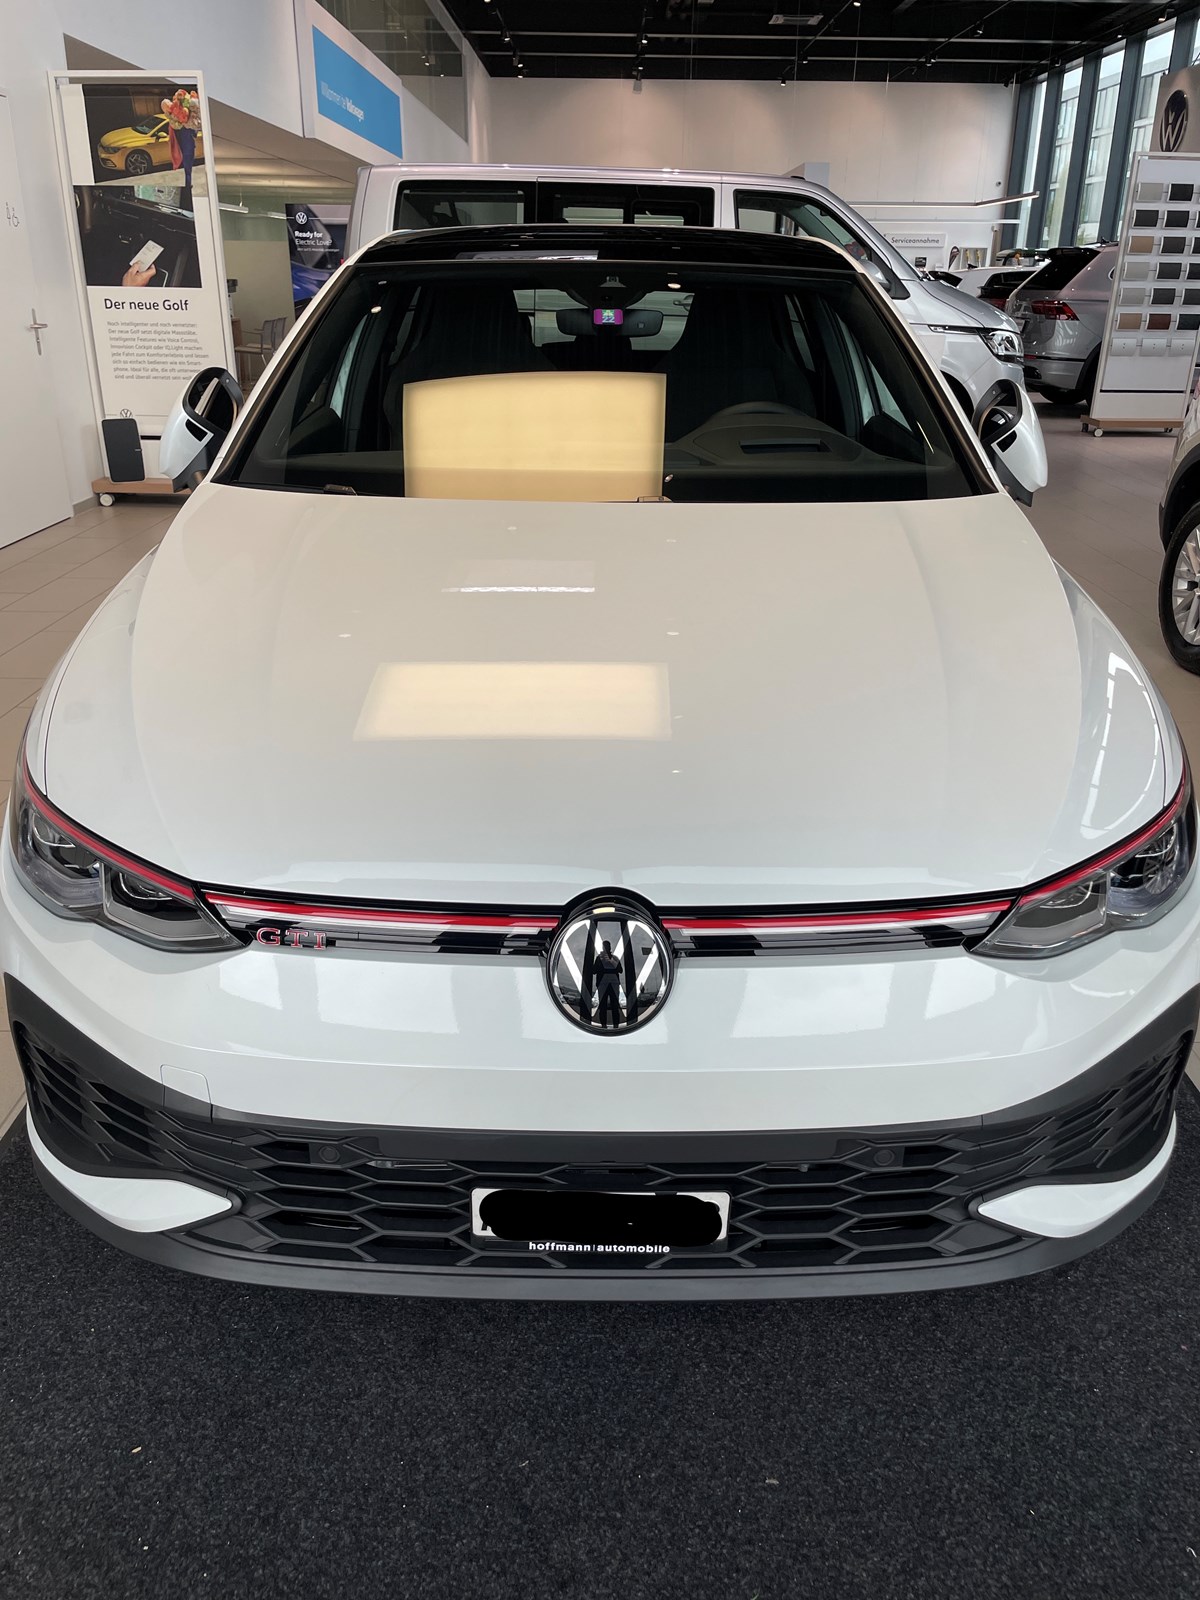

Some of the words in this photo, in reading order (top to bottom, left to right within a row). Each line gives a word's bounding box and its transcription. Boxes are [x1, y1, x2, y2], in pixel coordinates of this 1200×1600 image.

[104, 298, 126, 310] Der
[129, 301, 159, 310] neue
[162, 300, 189, 311] Golf
[256, 927, 326, 950] GTI
